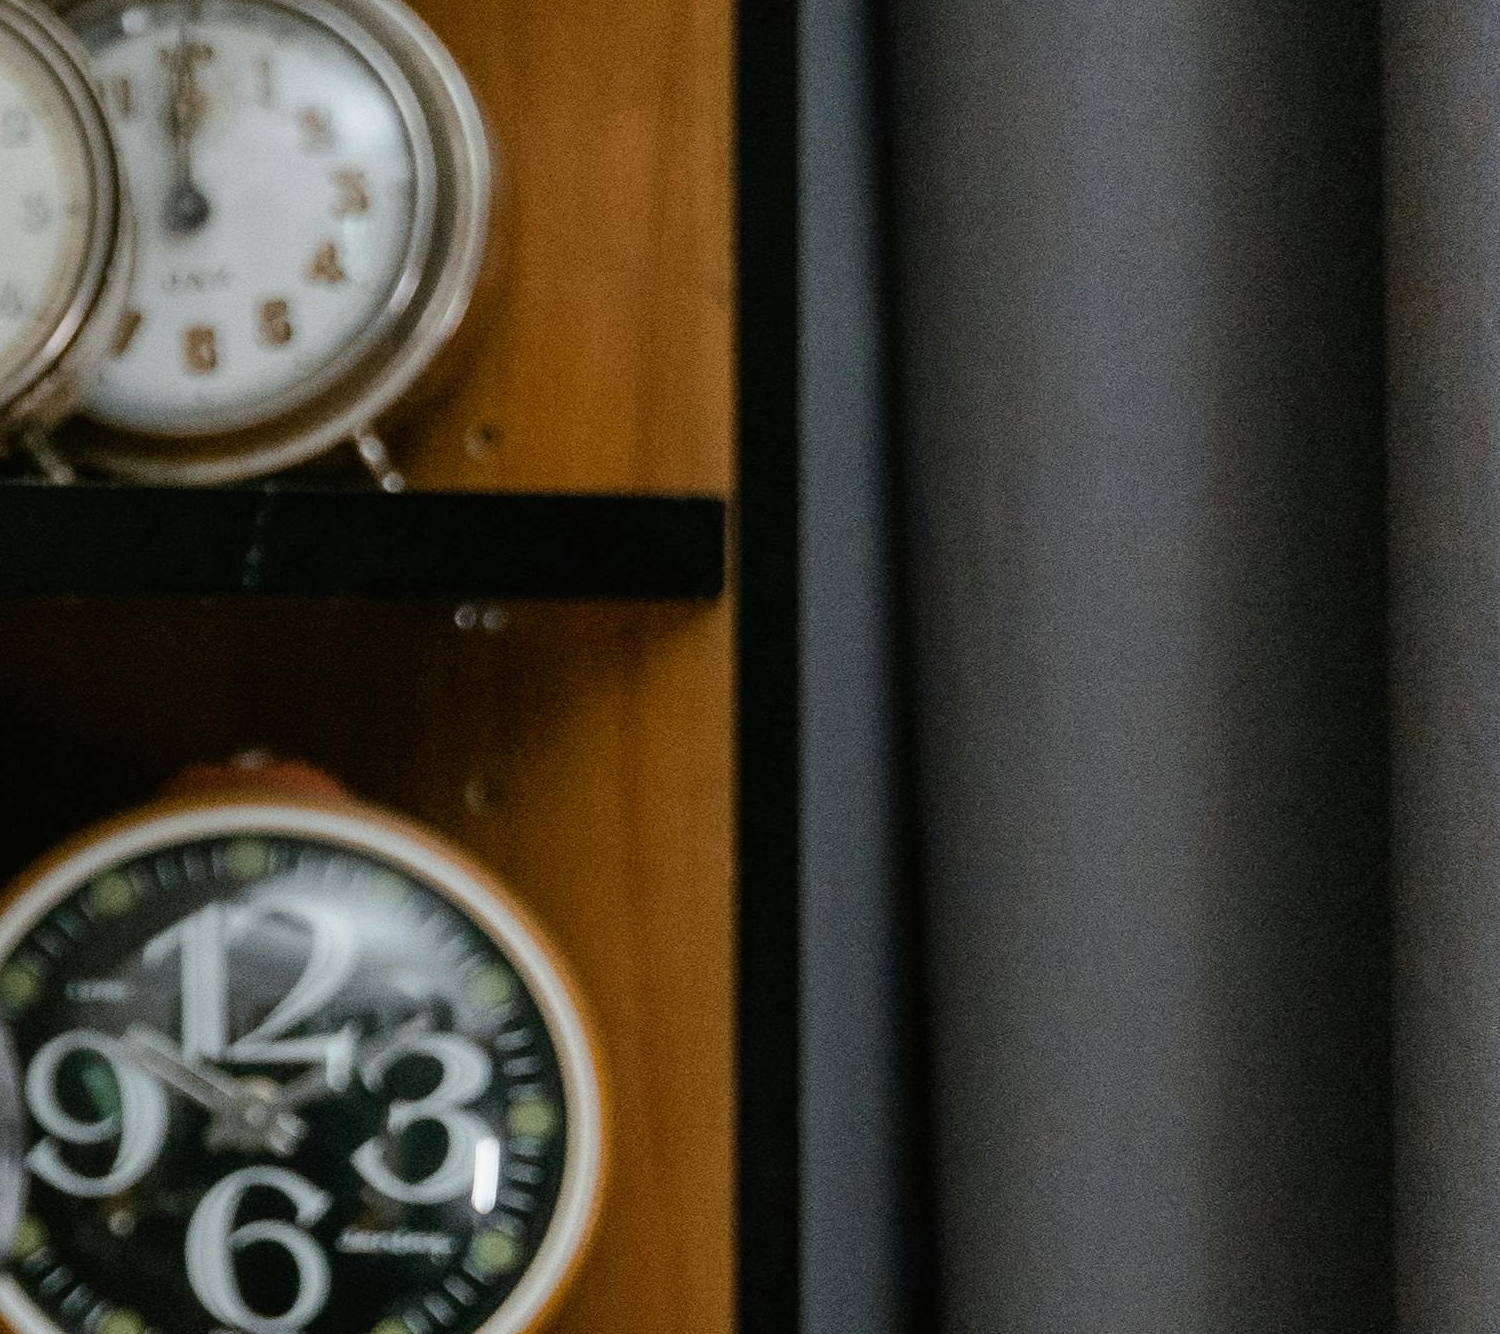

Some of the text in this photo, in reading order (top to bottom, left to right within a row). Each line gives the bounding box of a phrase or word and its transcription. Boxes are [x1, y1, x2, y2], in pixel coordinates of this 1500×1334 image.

[141, 886, 361, 1092] 12
[23, 1028, 169, 1198] 9
[349, 1029, 500, 1205] 3
